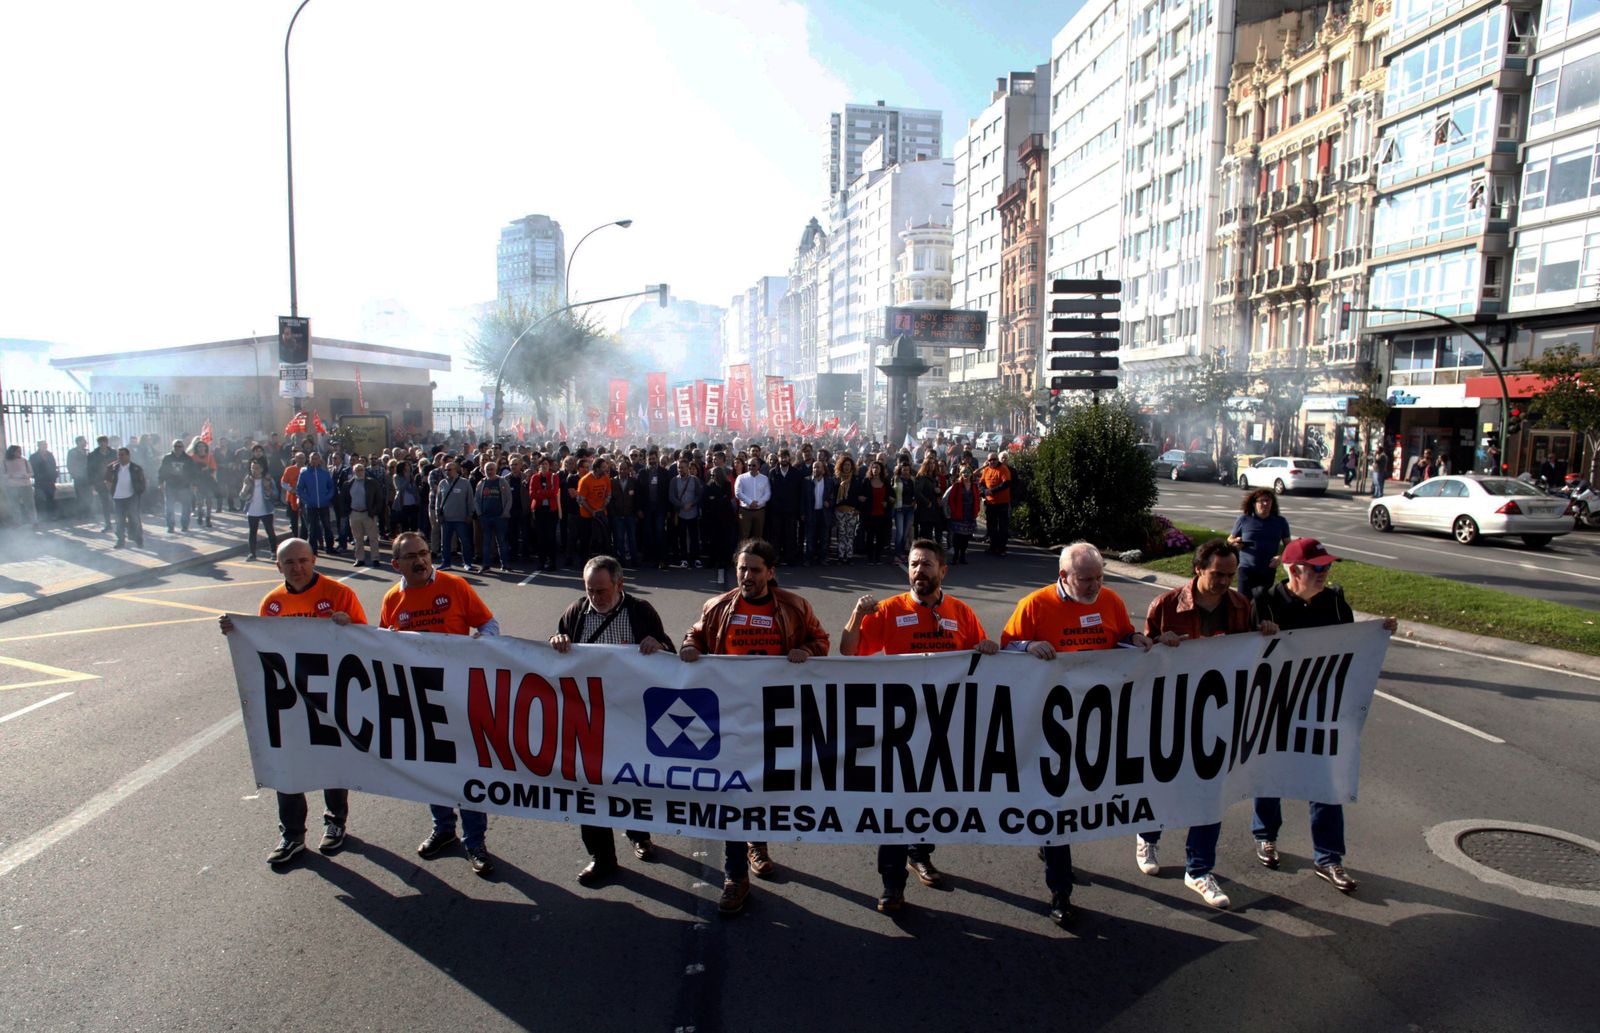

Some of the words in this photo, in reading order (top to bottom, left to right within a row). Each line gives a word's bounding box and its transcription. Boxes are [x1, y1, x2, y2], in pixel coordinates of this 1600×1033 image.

[914, 321, 926, 329] DE
[970, 324, 981, 332] 20
[920, 312, 938, 321] HOY
[257, 650, 457, 763] PECHE
[467, 667, 605, 785] NON
[762, 654, 1021, 794] ENERXÍA
[612, 762, 753, 793] ALCOA
[463, 777, 597, 814] COMITÉ
[606, 794, 656, 821] DE
[665, 798, 843, 839] EMPRESA
[855, 804, 987, 834] ALCOA
[998, 793, 1156, 836] CORUÑA
